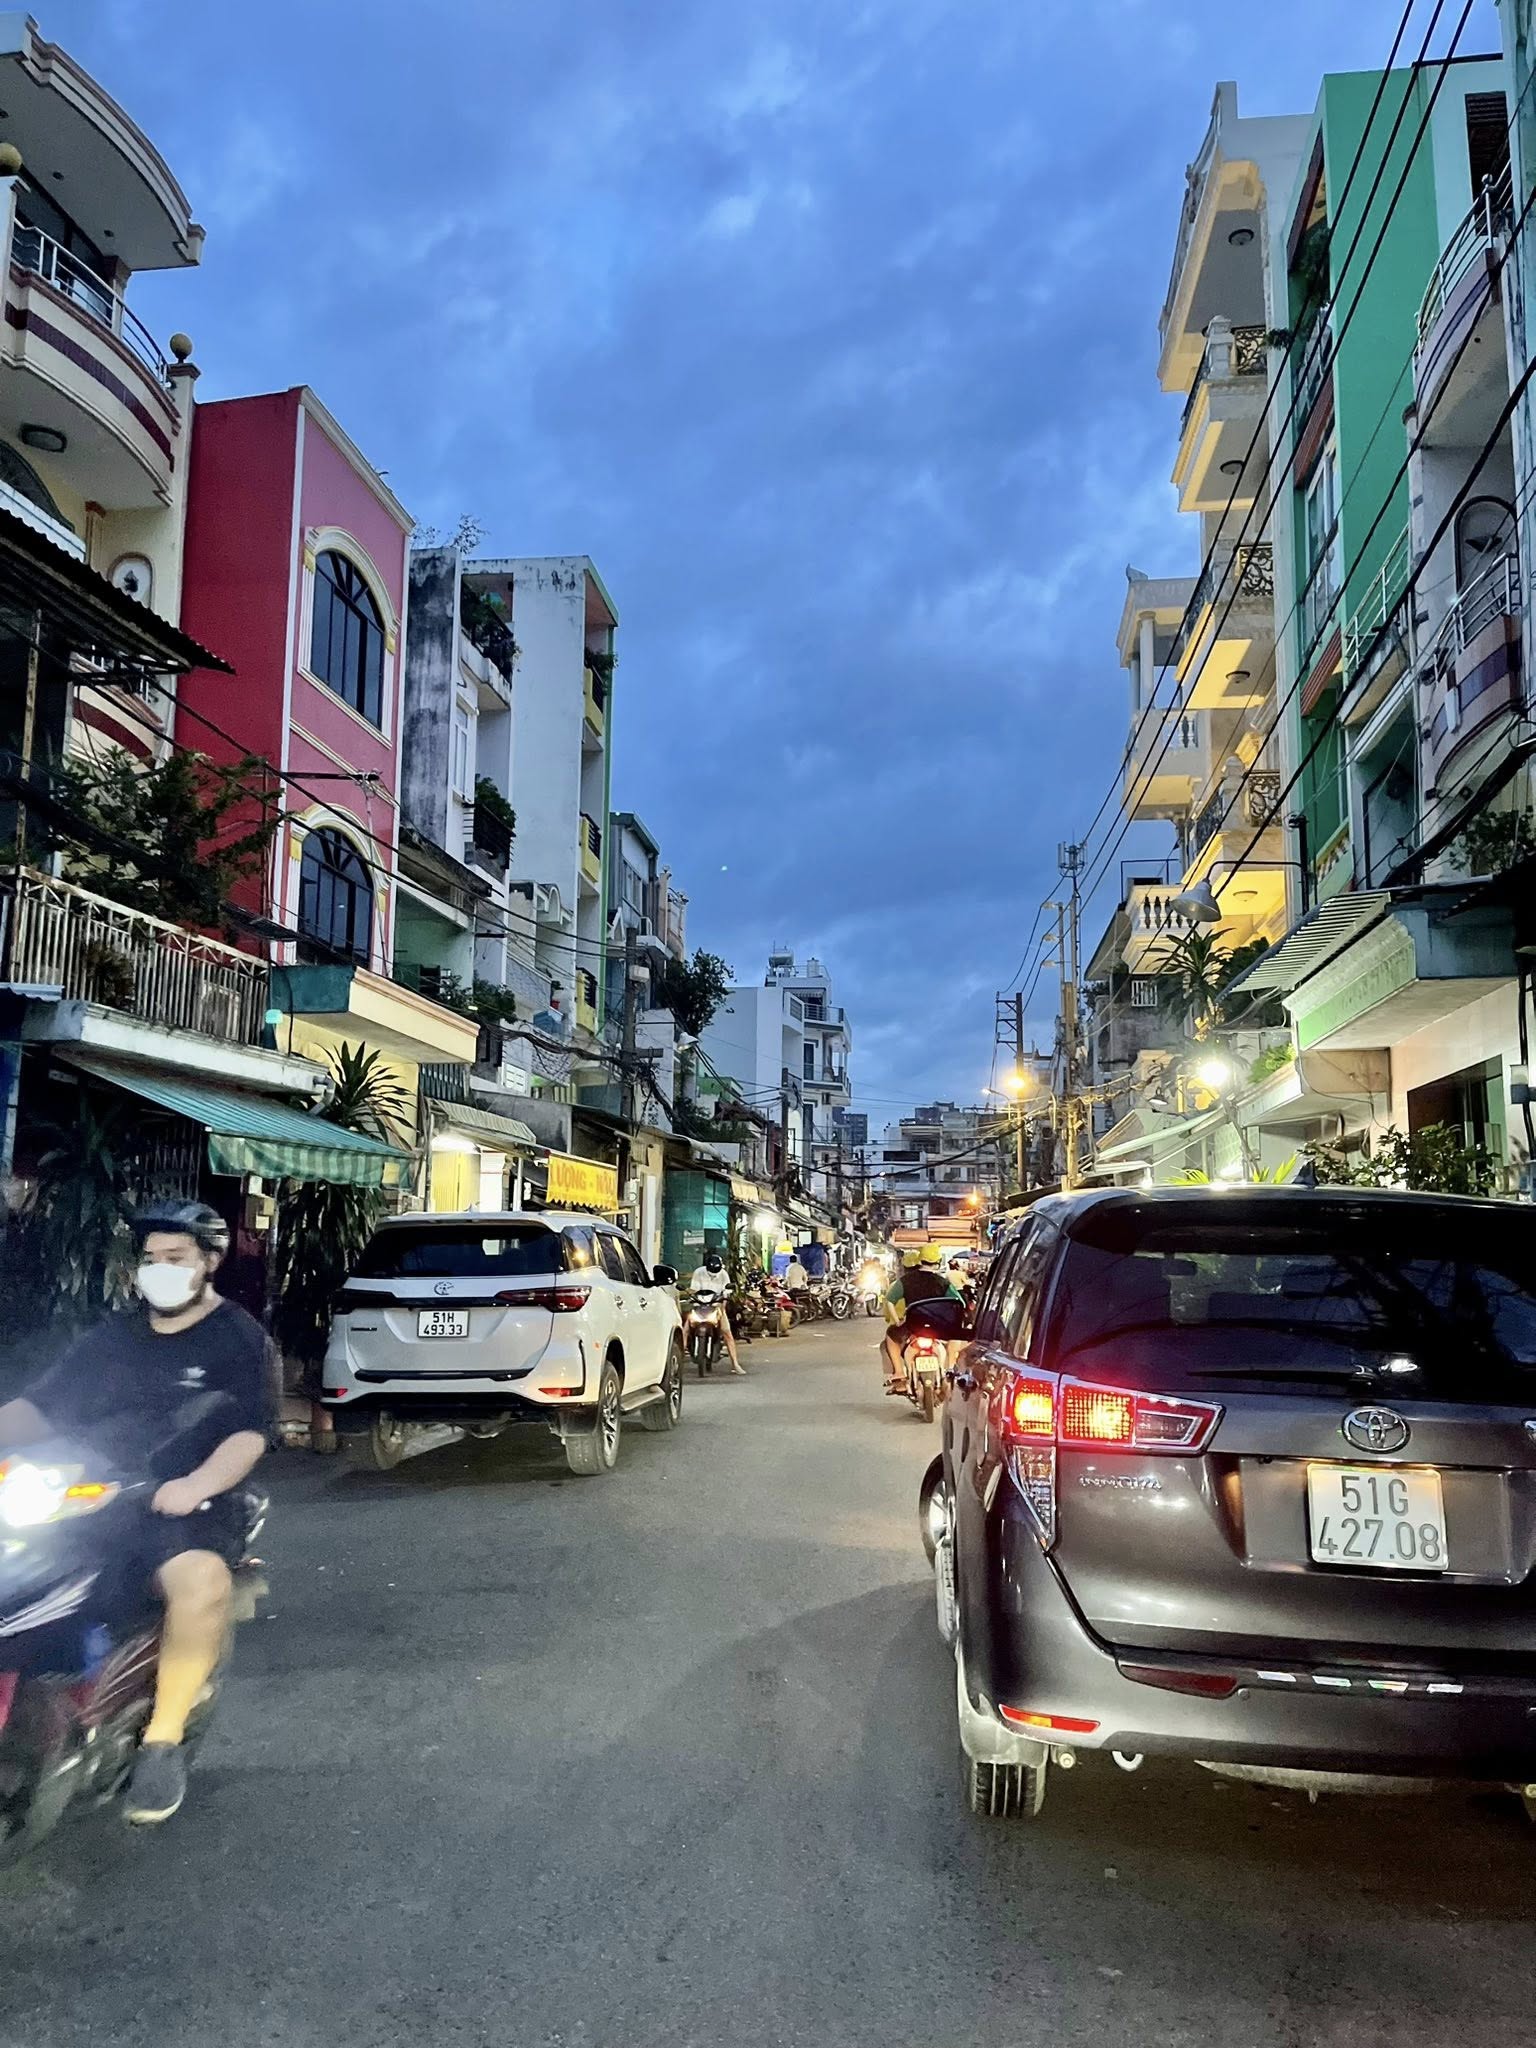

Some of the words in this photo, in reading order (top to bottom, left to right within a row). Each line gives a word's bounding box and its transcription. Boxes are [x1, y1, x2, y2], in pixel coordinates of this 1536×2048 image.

[423, 1324, 463, 1335] 493.33
[433, 1312, 454, 1323] 51H
[1341, 1475, 1409, 1516] 51G
[1319, 1516, 1440, 1562] 427.08
